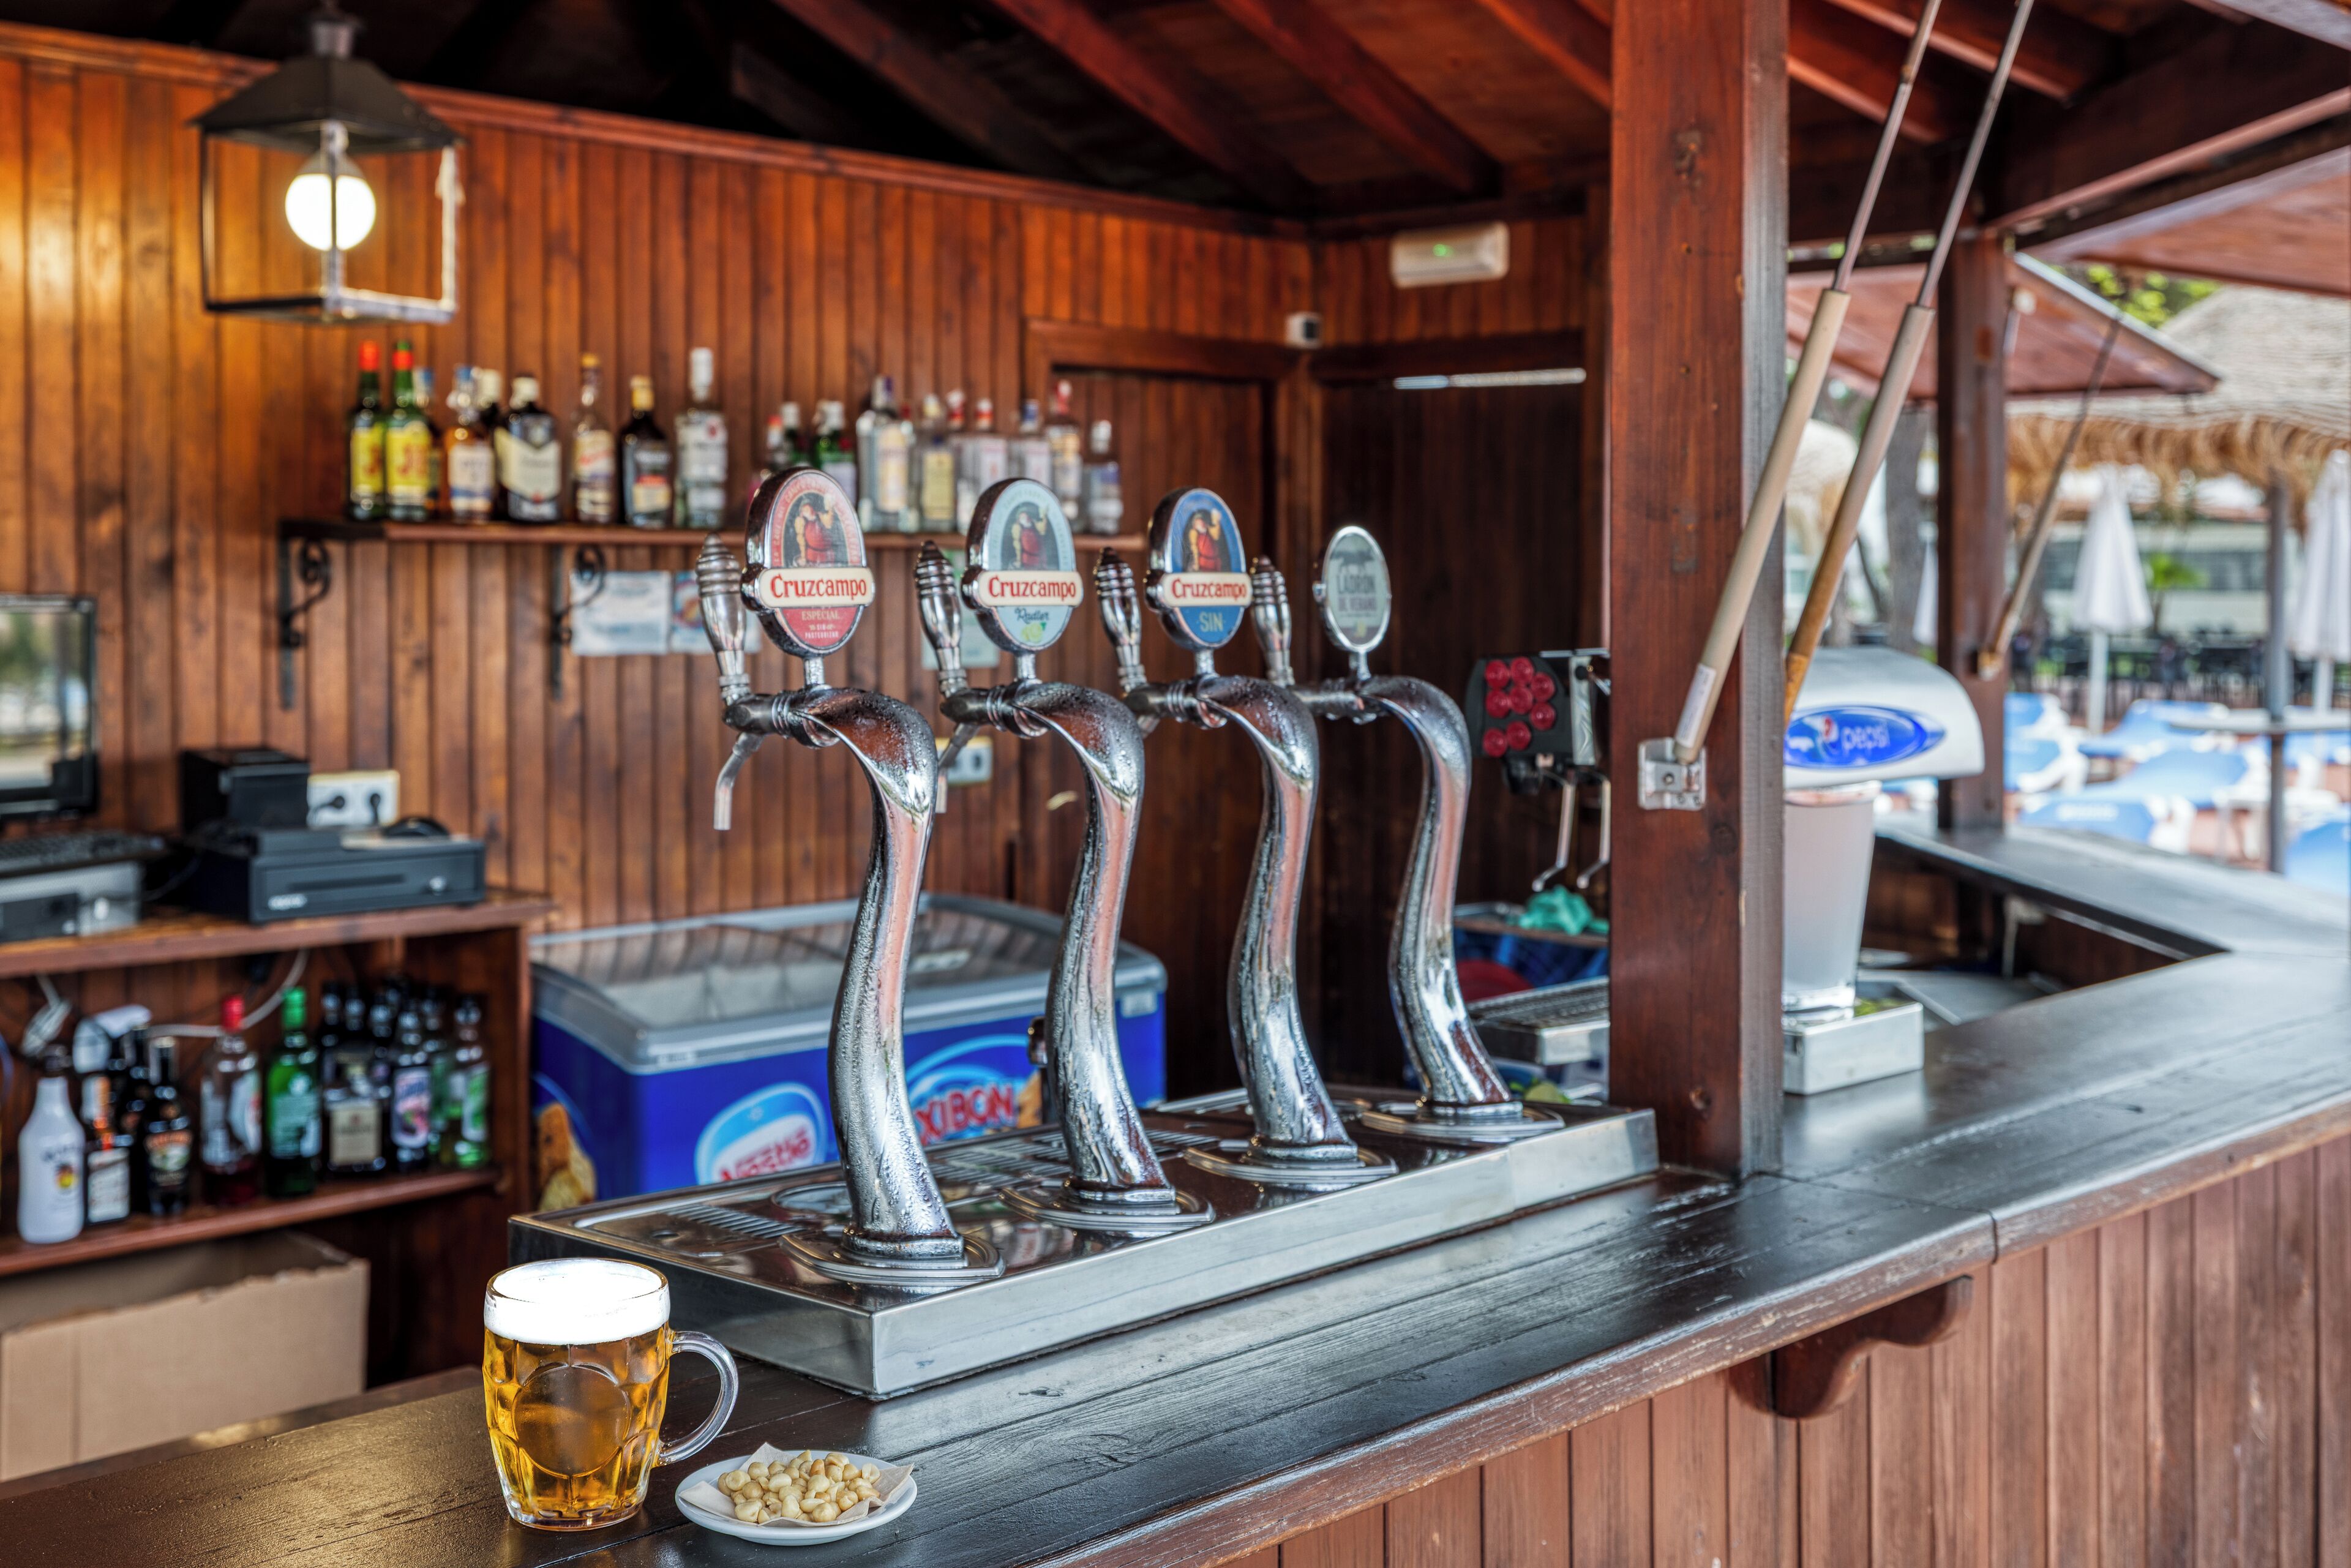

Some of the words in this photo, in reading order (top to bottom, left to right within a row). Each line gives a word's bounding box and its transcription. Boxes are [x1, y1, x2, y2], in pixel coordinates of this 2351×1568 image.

[770, 574, 867, 600] Cruzcampo
[988, 576, 1076, 601] Cruzcampo
[1171, 579, 1247, 601] Cruzcampo
[801, 610, 841, 621] ESPECIAL
[1014, 607, 1049, 625] Radler
[1199, 612, 1223, 632] SIN
[1842, 721, 1891, 757] pepsi
